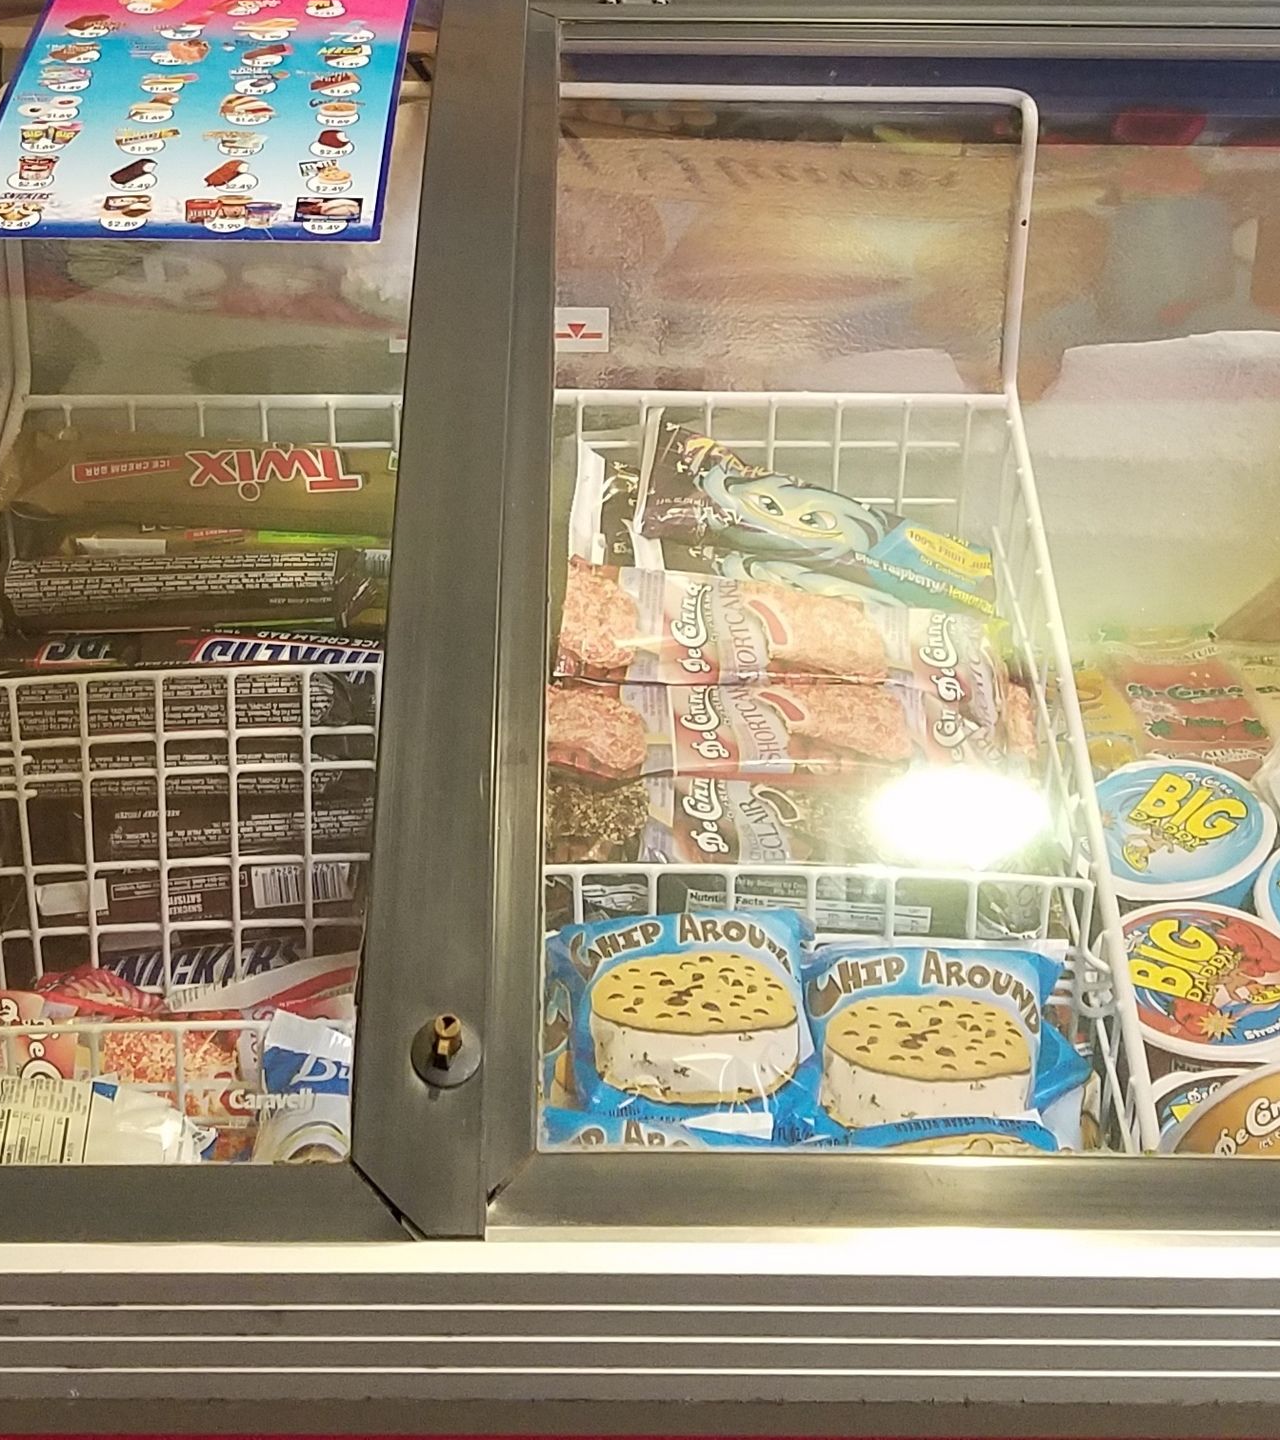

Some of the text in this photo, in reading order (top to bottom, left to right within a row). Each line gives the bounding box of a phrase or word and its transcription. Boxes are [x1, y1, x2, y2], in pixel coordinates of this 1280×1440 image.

[85, 465, 108, 476] BAR
[111, 461, 149, 473] CREAM
[1129, 771, 1249, 840] BIG
[735, 895, 765, 907] Facts
[1128, 918, 1220, 1001] BIG
[1186, 945, 1239, 1004] DADDY
[229, 1087, 316, 1111] Caravell
